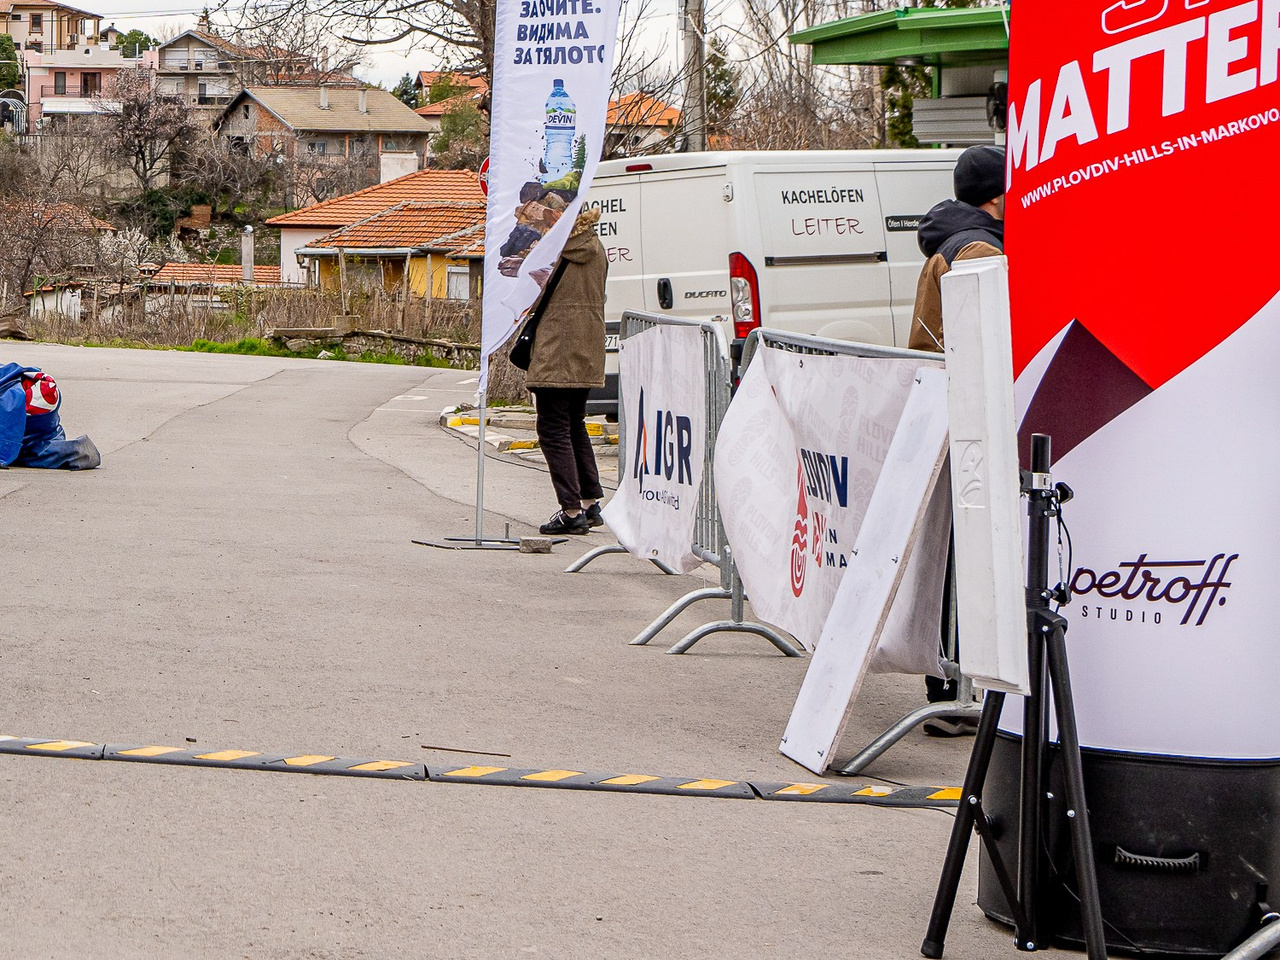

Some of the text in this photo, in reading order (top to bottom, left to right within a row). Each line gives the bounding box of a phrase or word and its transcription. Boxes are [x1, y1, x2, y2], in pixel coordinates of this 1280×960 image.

[517, 21, 589, 44] ВИДИМА
[548, 113, 573, 124] DEVIN
[781, 186, 864, 204] KACHELÖFEN
[580, 199, 626, 213] ACHEL
[591, 222, 617, 236] FEN
[791, 217, 864, 236] LEITER
[684, 290, 727, 299] DUCATO
[1082, 606, 1161, 624] STUDIO
